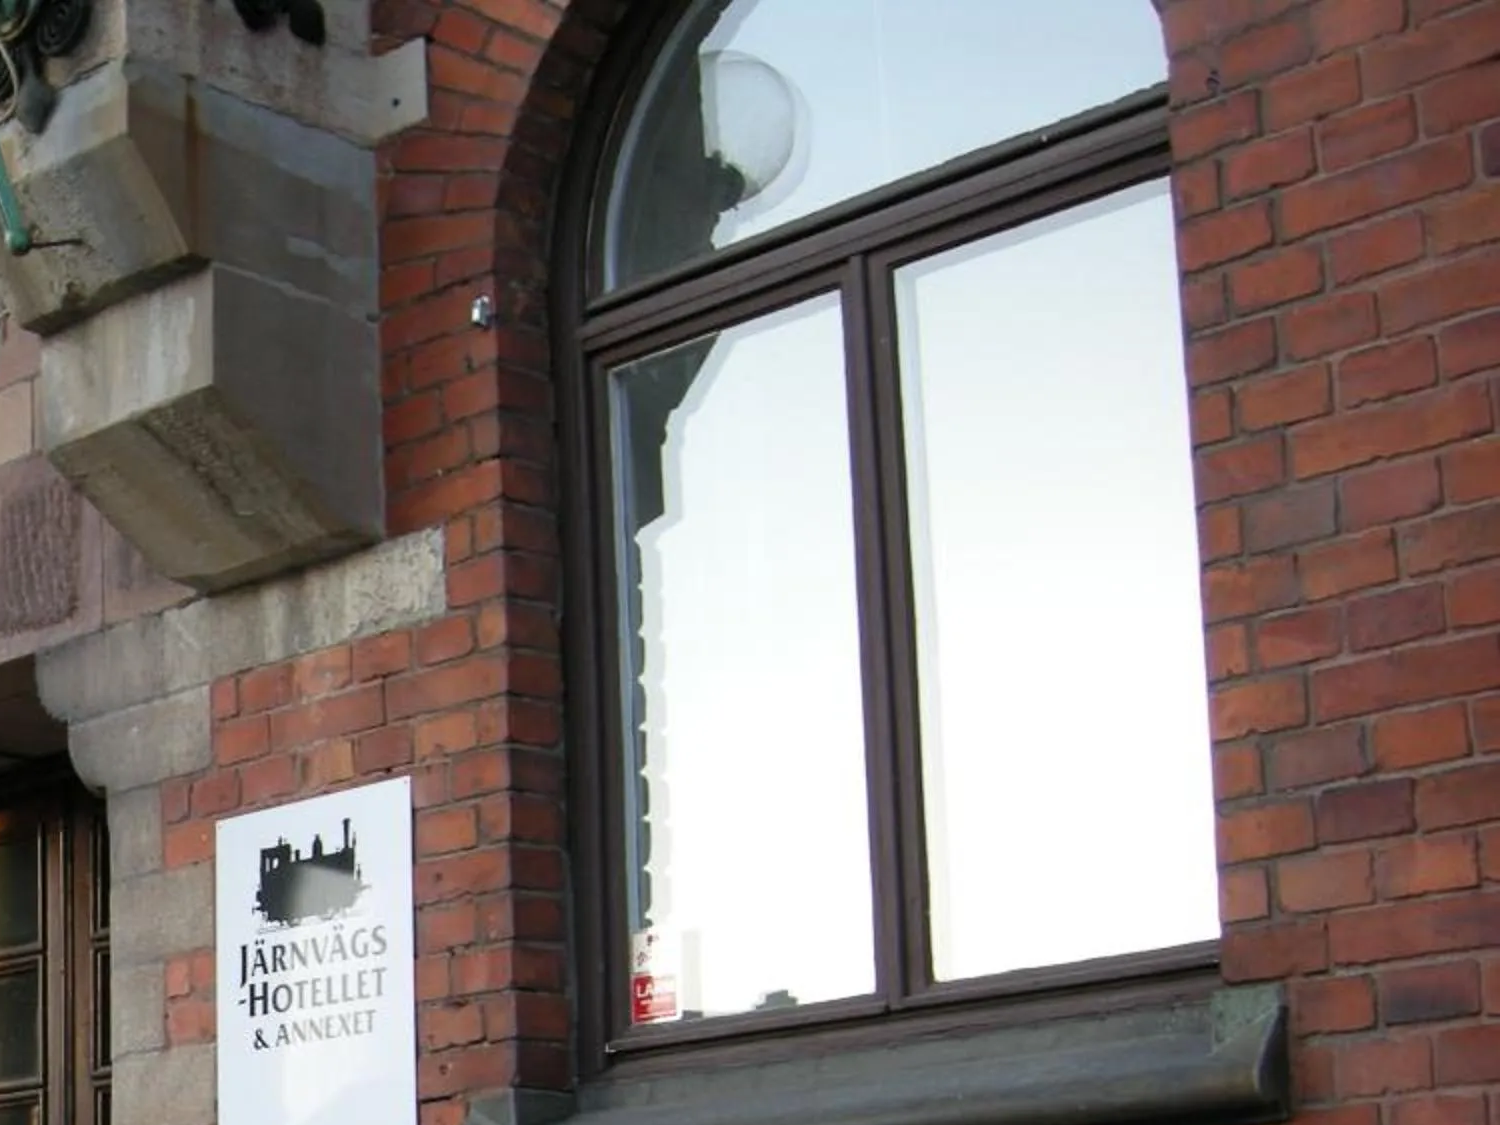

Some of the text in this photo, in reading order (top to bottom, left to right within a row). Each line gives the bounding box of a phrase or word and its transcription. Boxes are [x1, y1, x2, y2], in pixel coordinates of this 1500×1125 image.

[240, 925, 387, 987] JÄRNVÄGS
[238, 967, 387, 1018] -HOTELLET
[253, 1010, 376, 1051] & ANNEXET
